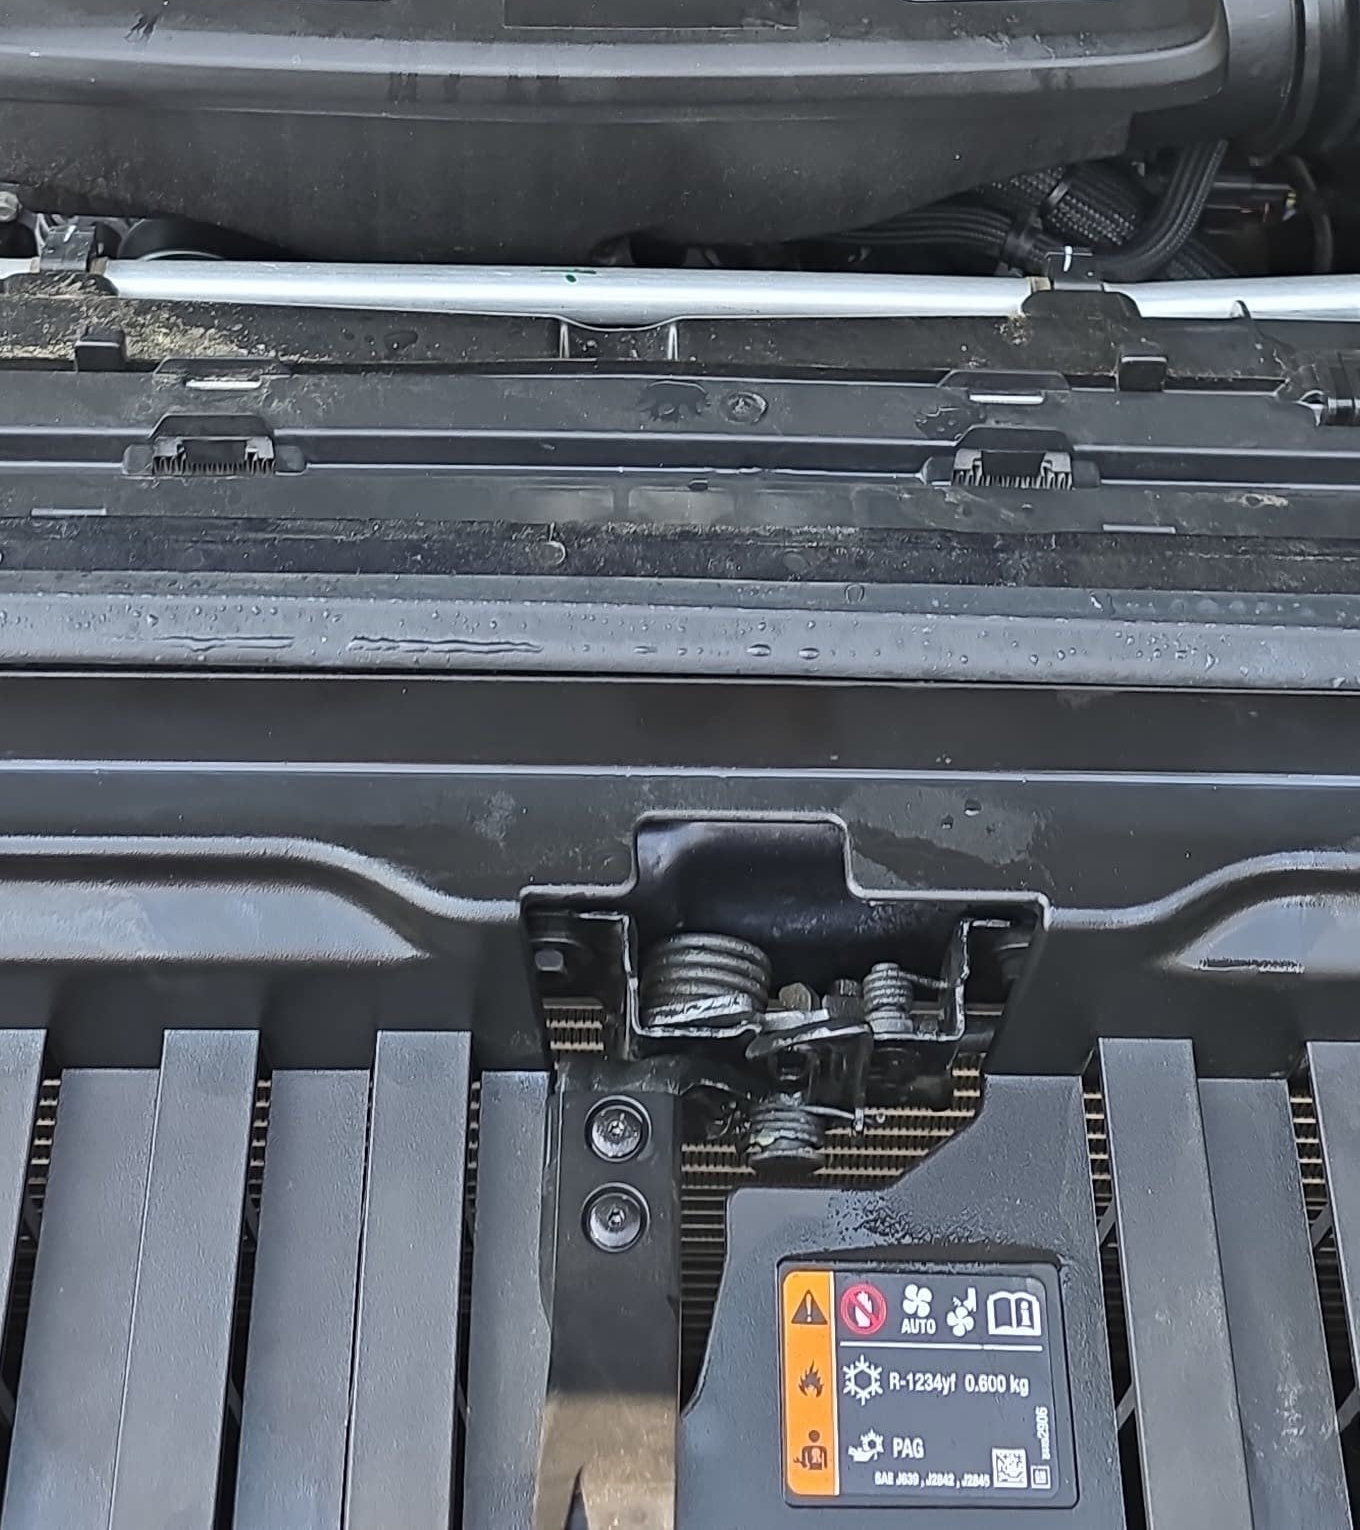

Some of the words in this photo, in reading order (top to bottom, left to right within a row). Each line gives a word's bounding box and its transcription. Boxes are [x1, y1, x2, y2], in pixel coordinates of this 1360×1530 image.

[901, 1318, 937, 1335] AUTO
[890, 1372, 956, 1396] R-1234yf
[965, 1373, 1007, 1393] 0.600
[1010, 1374, 1029, 1397] kg
[893, 1437, 925, 1459] PAG
